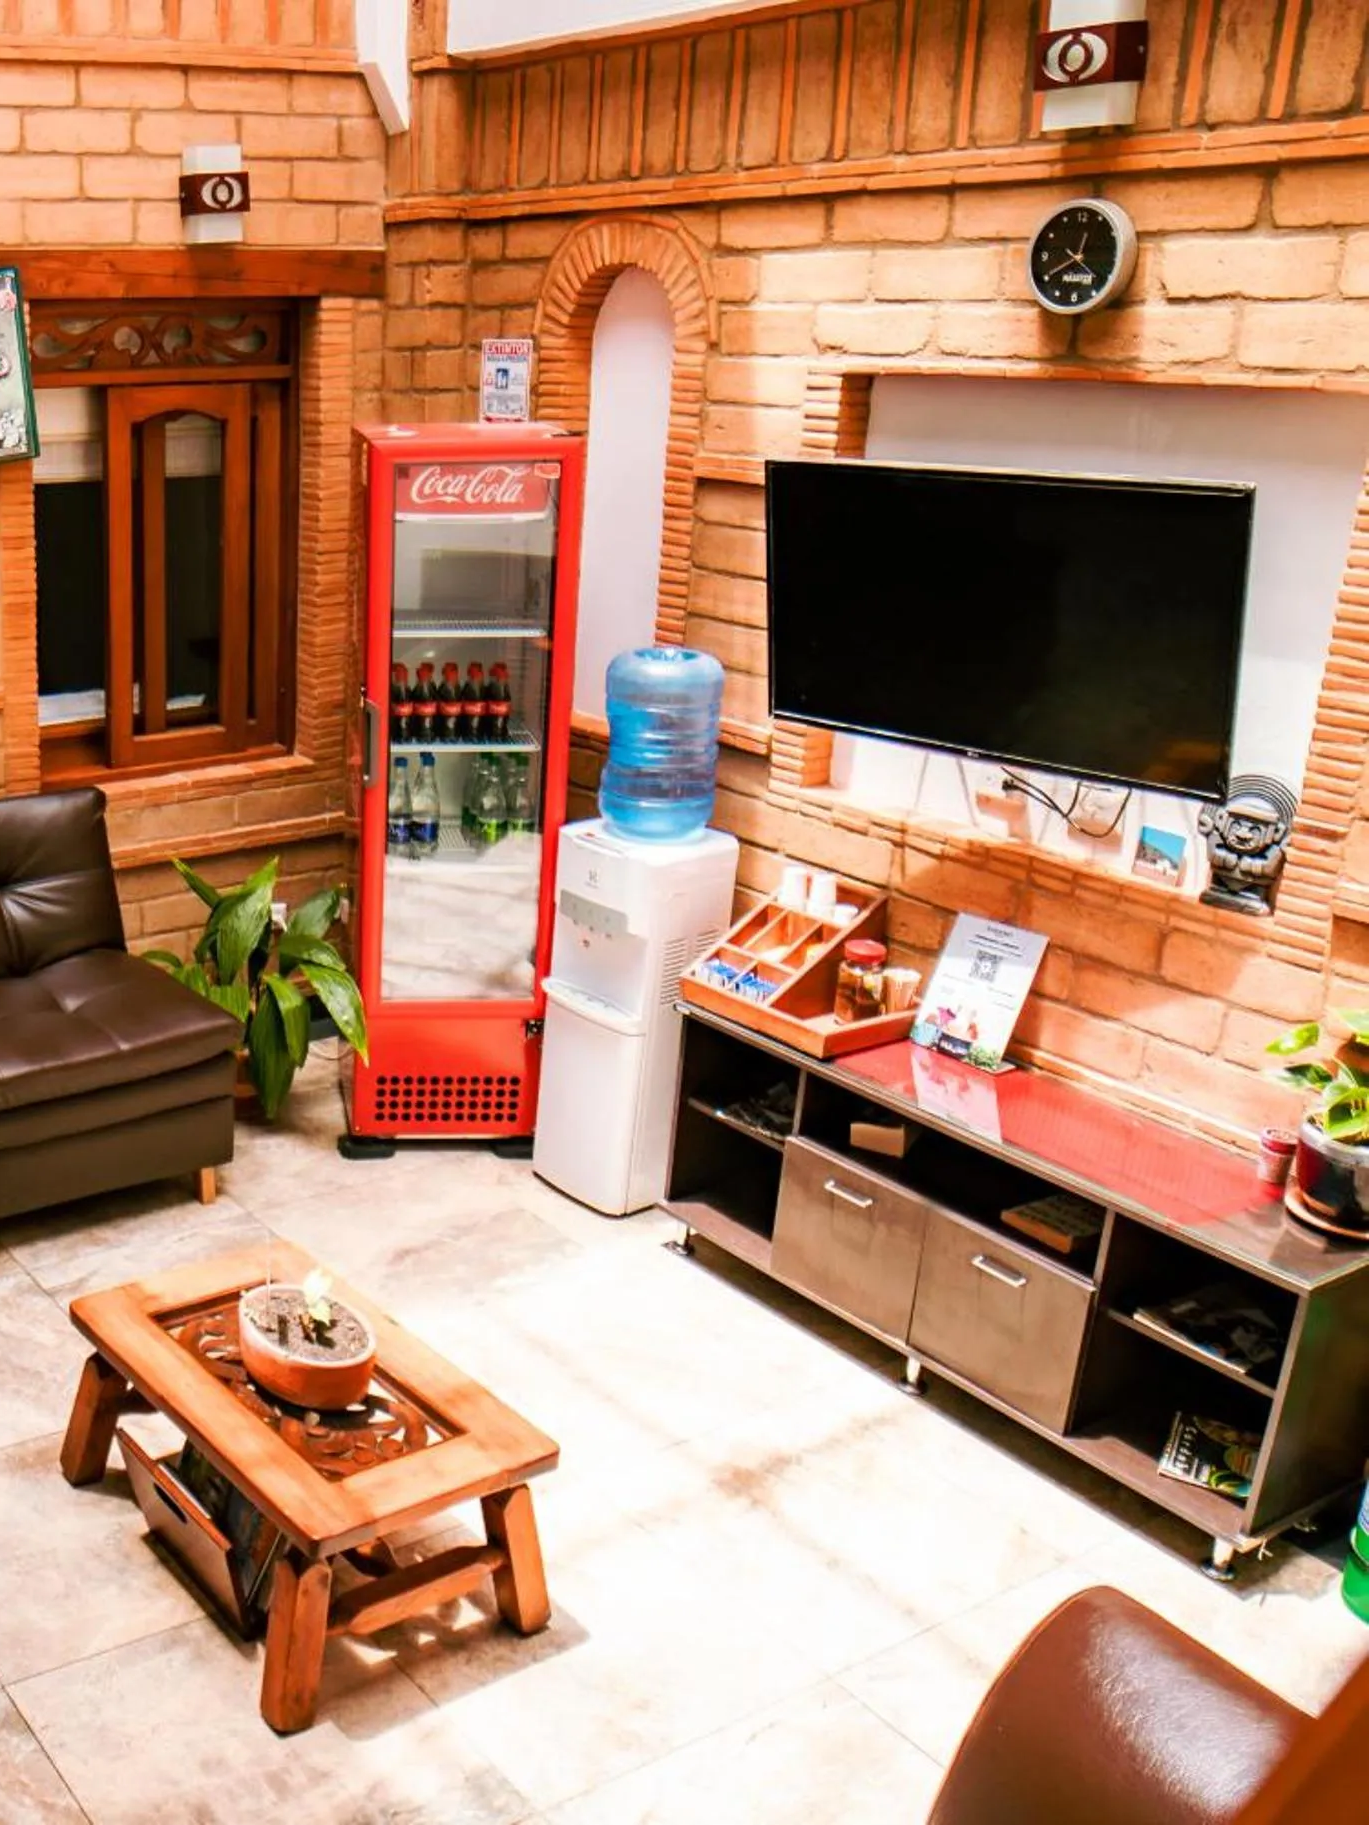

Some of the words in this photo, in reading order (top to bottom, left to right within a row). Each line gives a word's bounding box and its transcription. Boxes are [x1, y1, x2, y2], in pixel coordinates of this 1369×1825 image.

[1041, 251, 1049, 262] 9
[1071, 291, 1078, 302] 6
[410, 465, 531, 504] Coca-Cola
